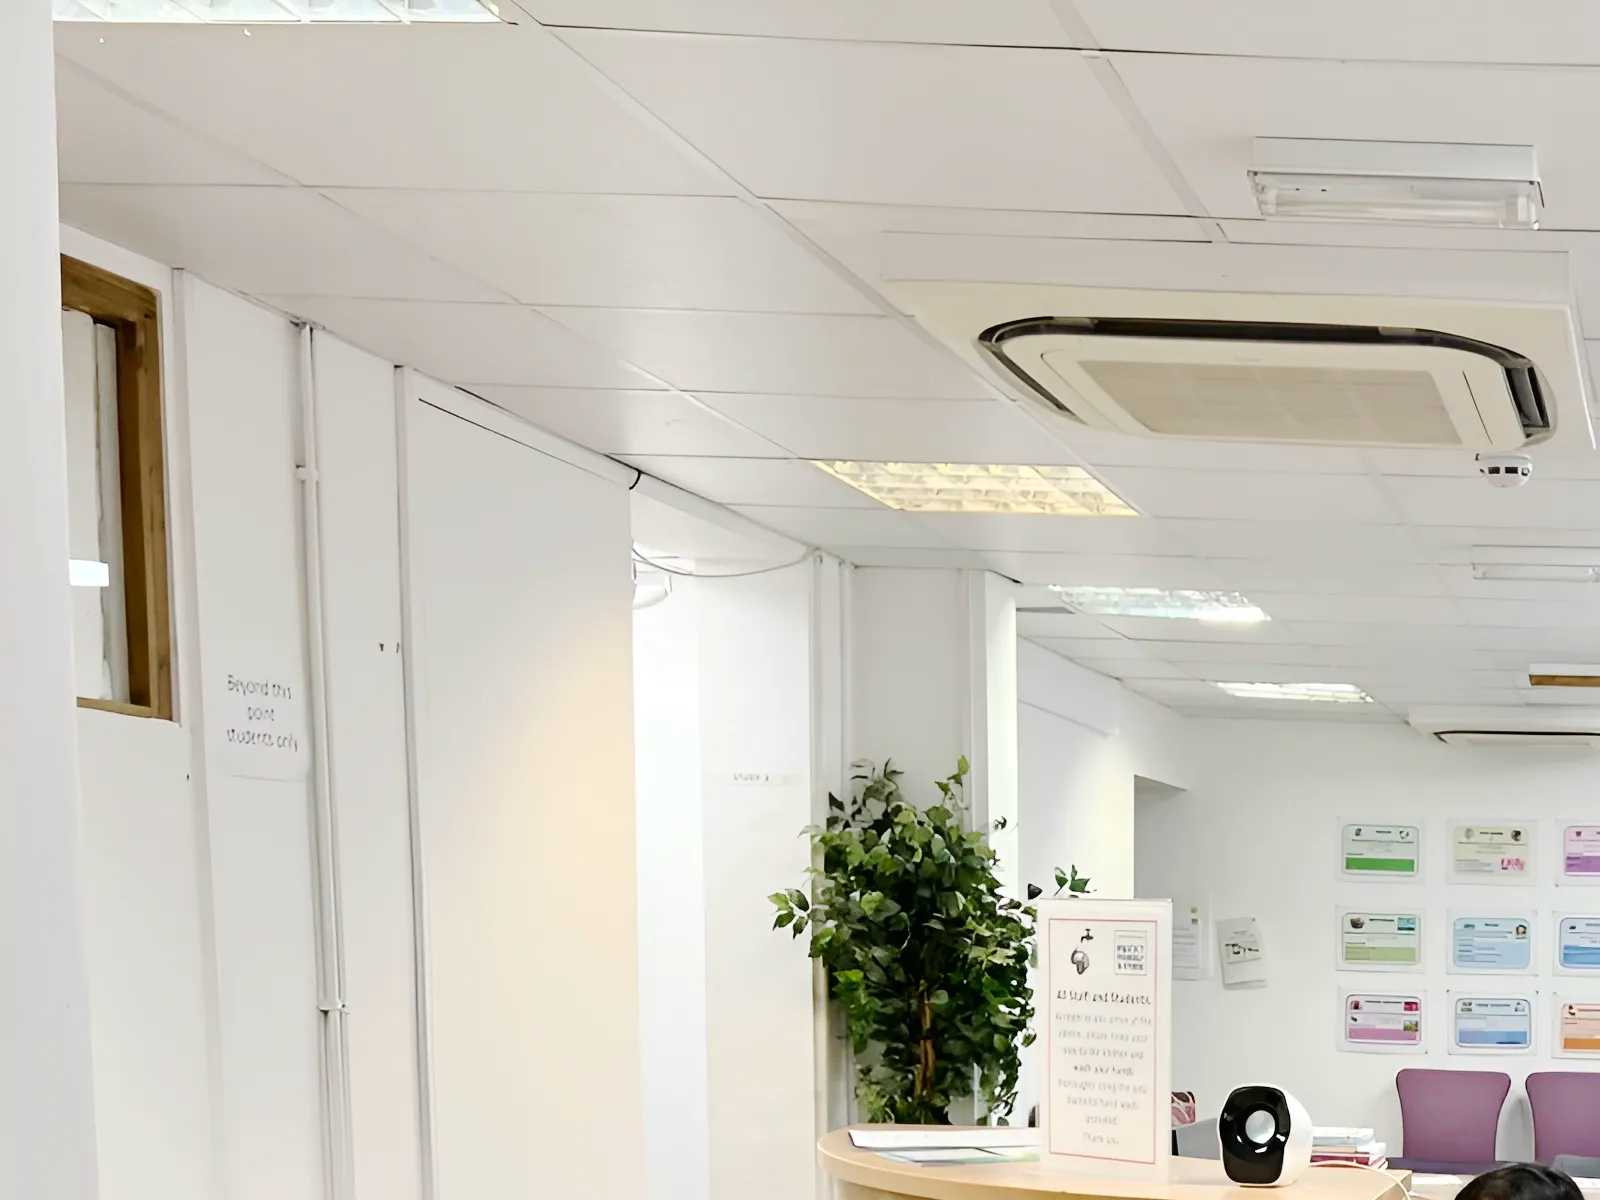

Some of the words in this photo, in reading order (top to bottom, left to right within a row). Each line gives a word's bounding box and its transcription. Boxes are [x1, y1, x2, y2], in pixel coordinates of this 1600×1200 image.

[227, 674, 268, 696] Beyond
[226, 728, 274, 747] students
[276, 734, 298, 753] only
